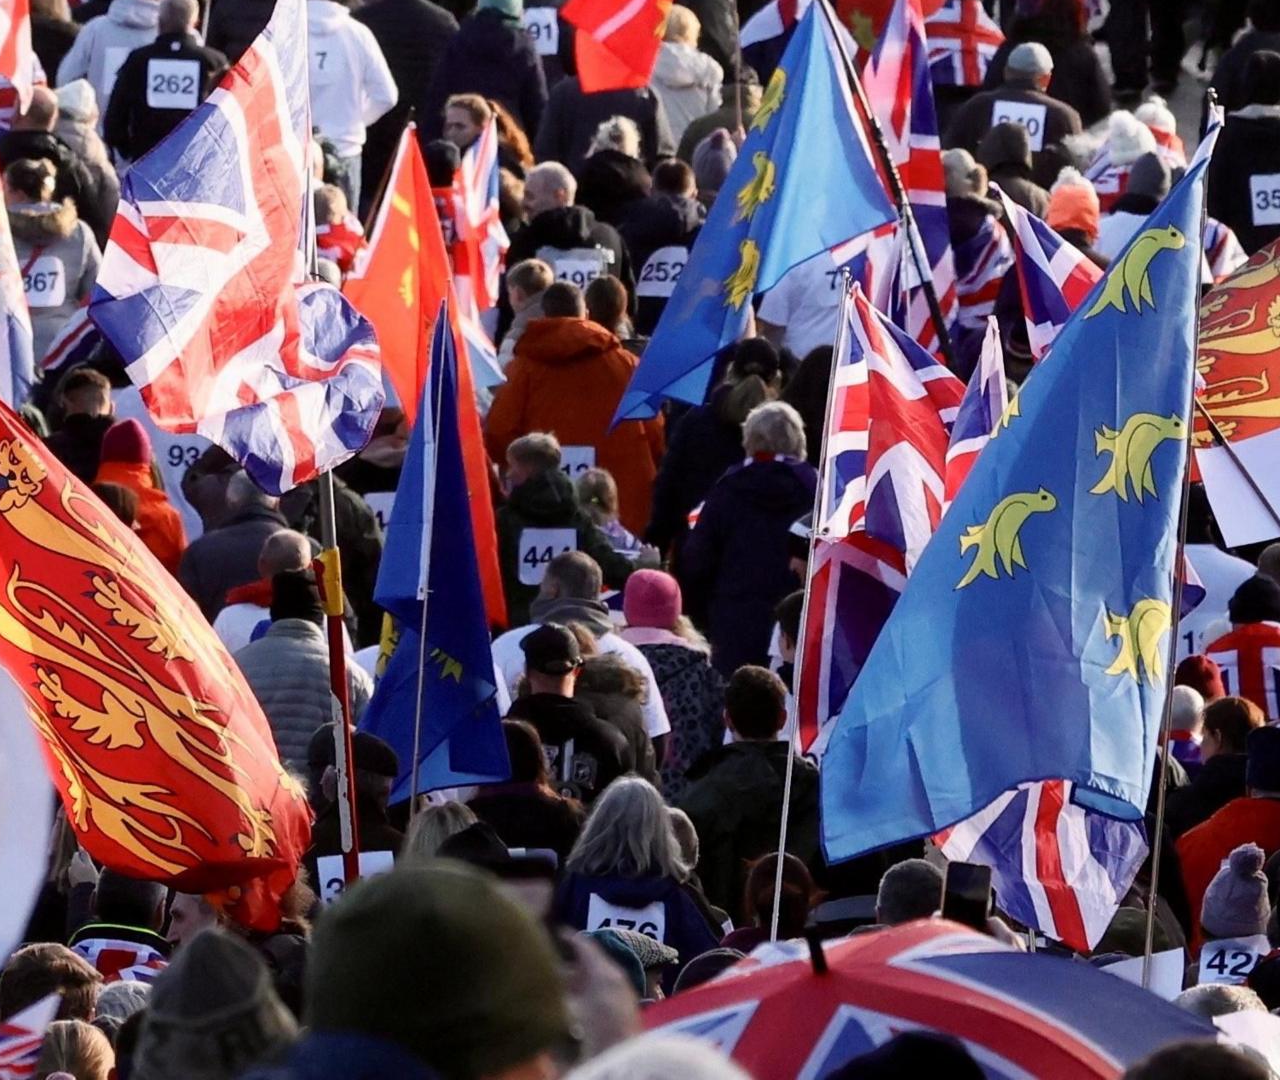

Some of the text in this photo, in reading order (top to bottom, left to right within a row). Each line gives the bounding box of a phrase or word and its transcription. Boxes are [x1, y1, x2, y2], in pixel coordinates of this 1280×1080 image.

[153, 73, 195, 95] 262
[641, 261, 685, 282] 252
[167, 444, 200, 468] 93
